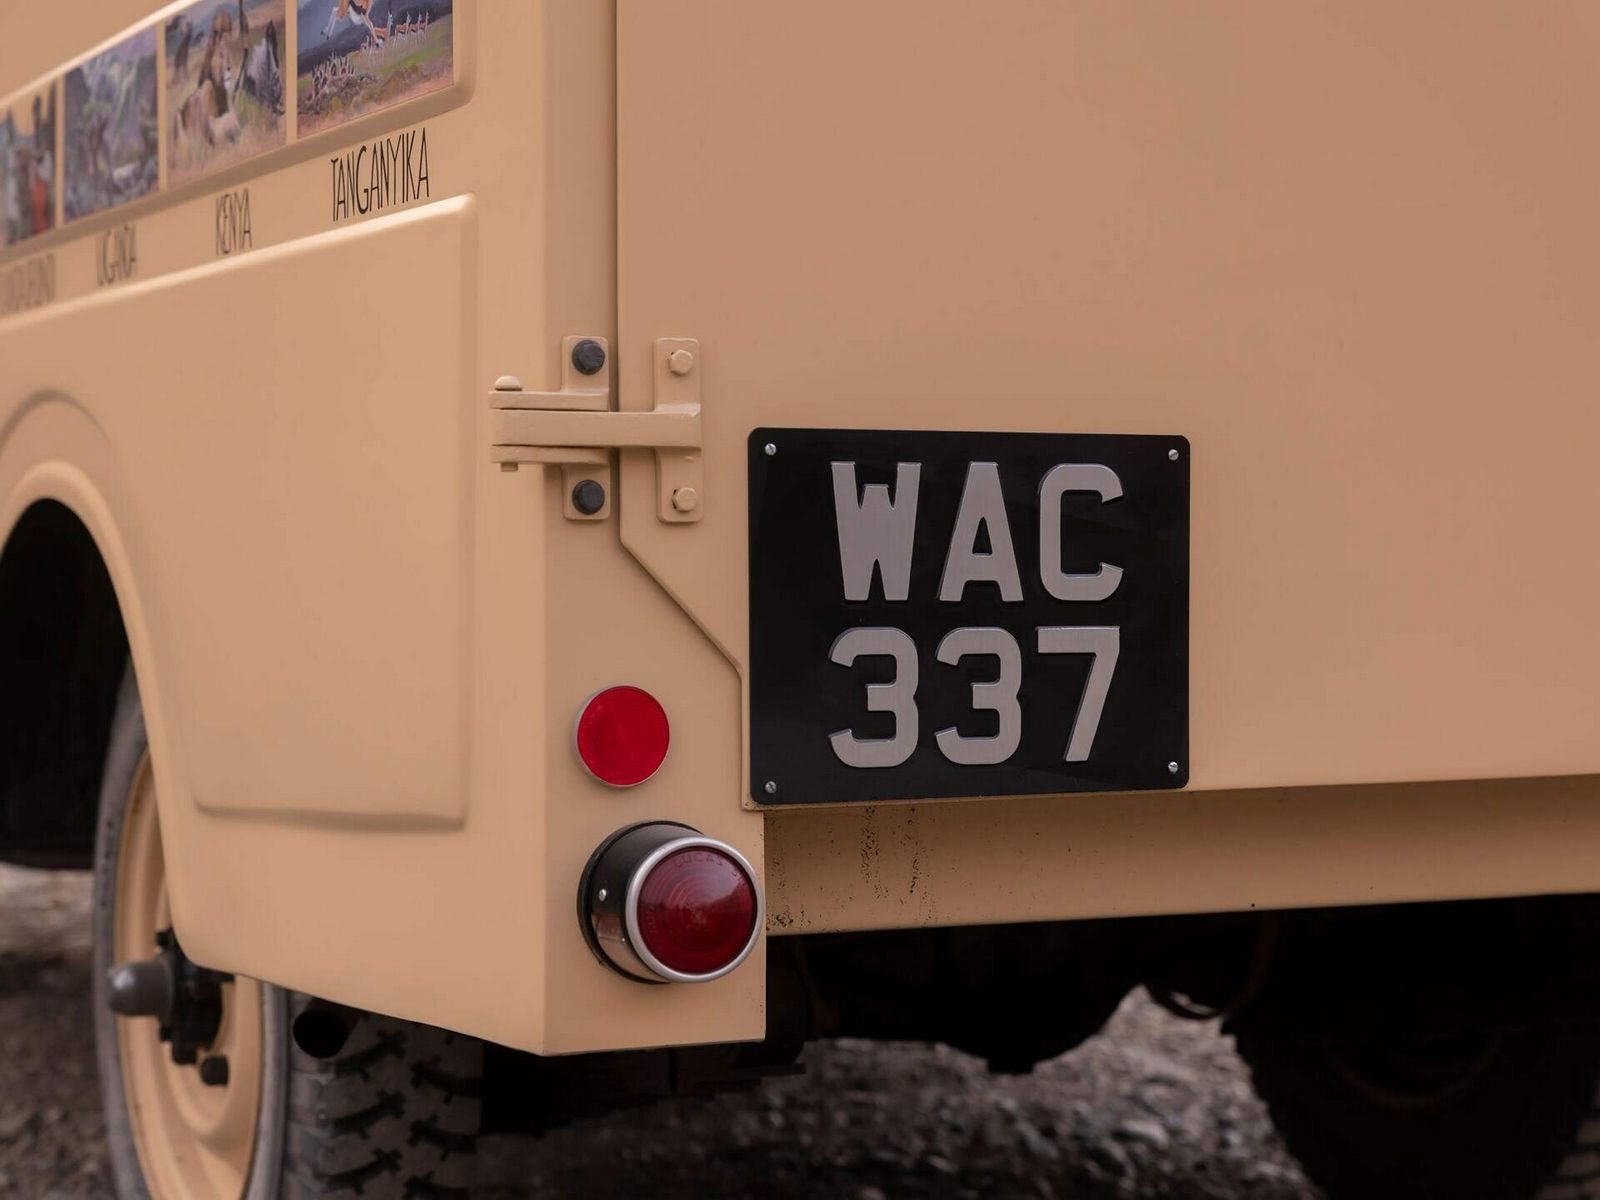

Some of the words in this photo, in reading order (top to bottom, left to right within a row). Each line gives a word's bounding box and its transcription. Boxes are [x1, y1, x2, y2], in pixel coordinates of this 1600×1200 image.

[215, 188, 253, 256] KENYA
[330, 127, 430, 222] TANGANYIKA
[830, 461, 1124, 602] WAC
[828, 625, 1121, 768] 337
[674, 851, 724, 868] LUCAS
